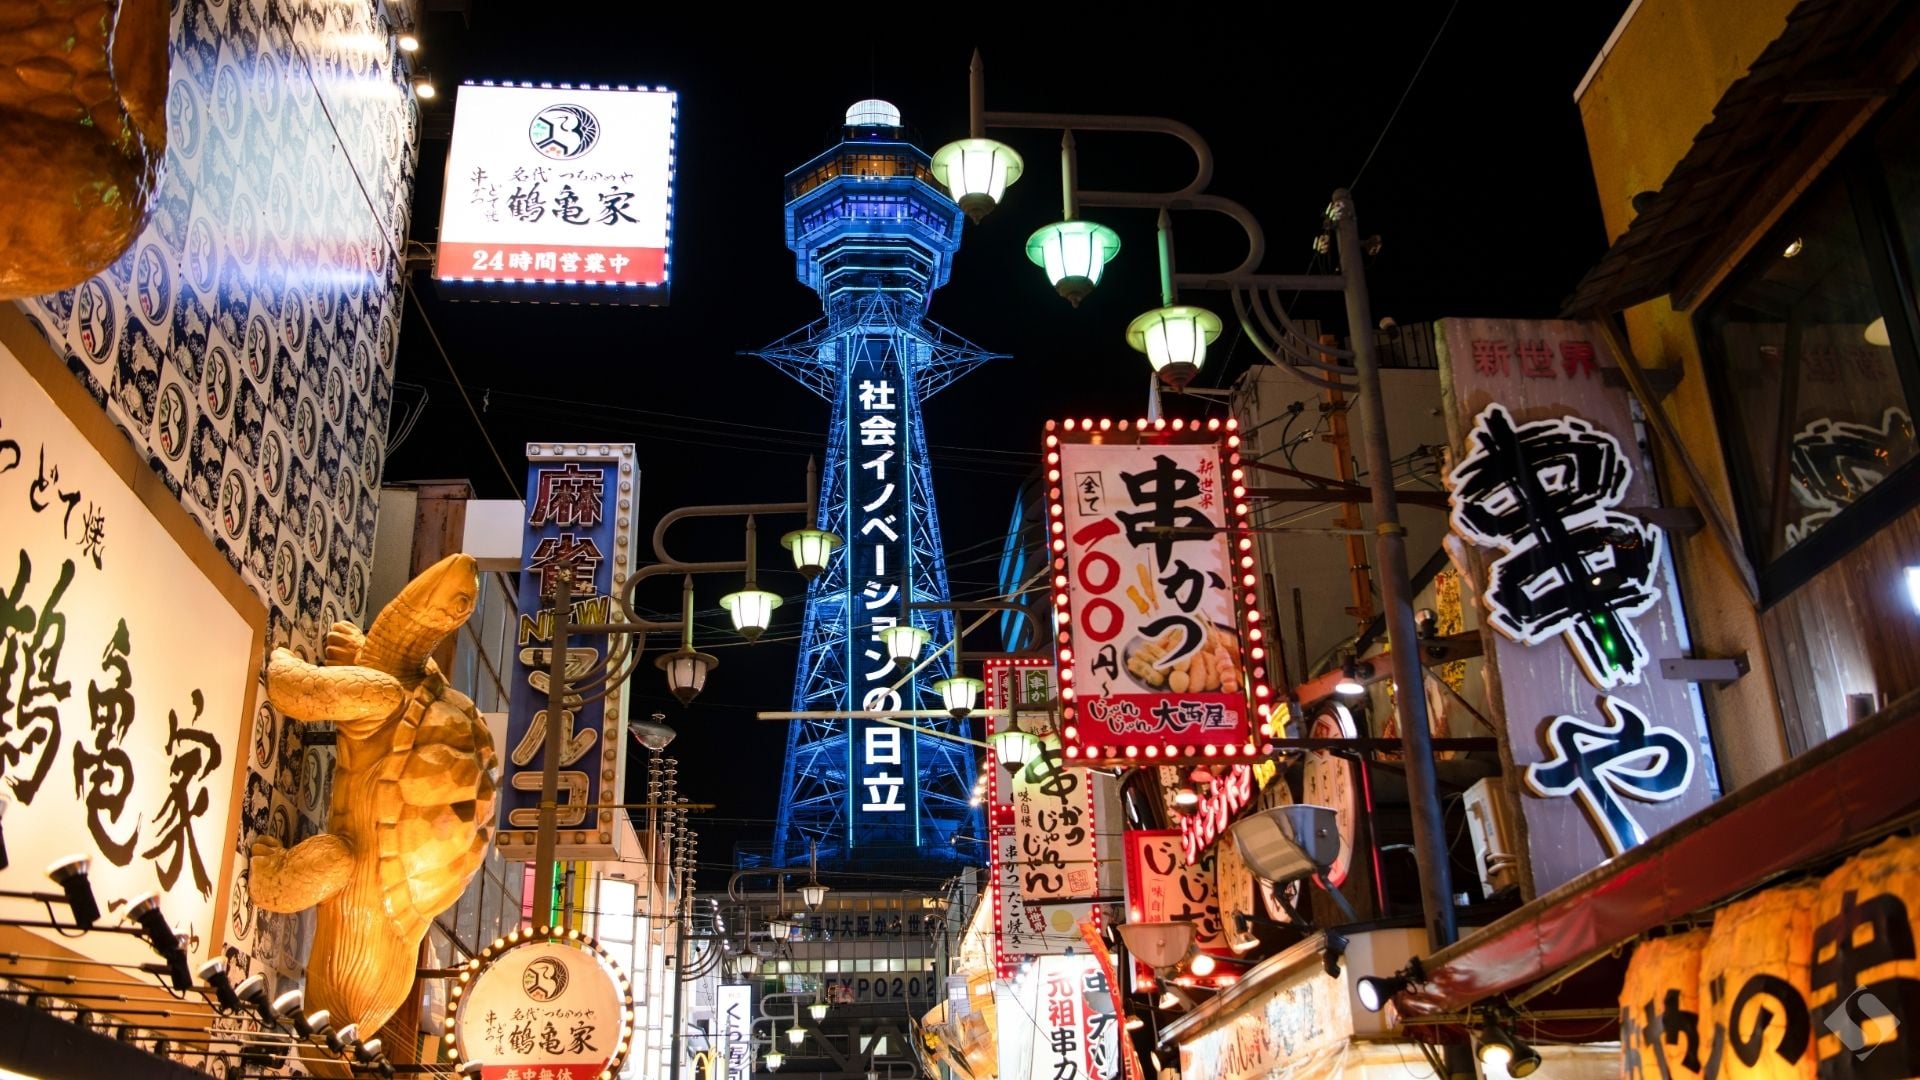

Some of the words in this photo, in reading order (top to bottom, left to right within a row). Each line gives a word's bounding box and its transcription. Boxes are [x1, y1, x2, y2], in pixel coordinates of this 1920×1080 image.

[511, 166, 551, 182] 名代
[508, 182, 640, 226] 鶴亀家
[472, 249, 631, 274] 24時間営業中
[1473, 338, 1597, 379] 新世界
[1078, 474, 1101, 513] 全て
[1196, 457, 1216, 510] 新世界
[514, 462, 604, 598] 麻雀
[1115, 454, 1226, 669] 串かつ
[509, 647, 600, 828] マルコ
[1151, 700, 1235, 734] 大西屋
[1017, 787, 1033, 828] 味自慢
[1025, 740, 1086, 847] 串かつ
[1037, 809, 1066, 869] じゃん
[1022, 832, 1064, 894] じゃん
[1007, 891, 1025, 949] たこ焼き
[510, 1007, 540, 1021] 名代
[508, 1020, 599, 1055] 鶴亀家
